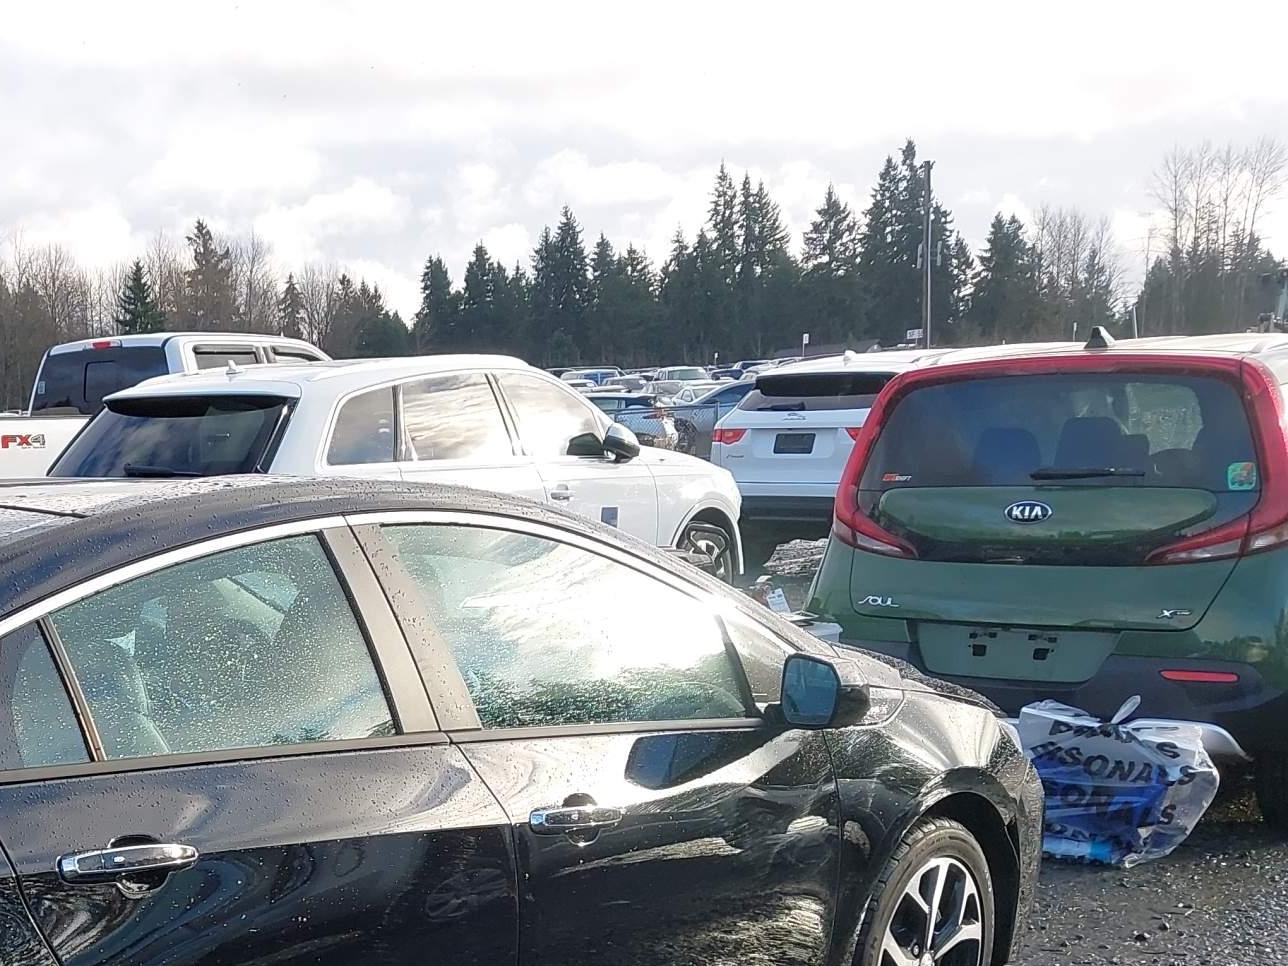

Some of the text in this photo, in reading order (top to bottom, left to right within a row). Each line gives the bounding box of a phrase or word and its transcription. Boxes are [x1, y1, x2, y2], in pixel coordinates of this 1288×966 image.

[1, 433, 46, 448] FX4
[1011, 505, 1043, 519] KIA
[857, 595, 900, 607] SOUL
